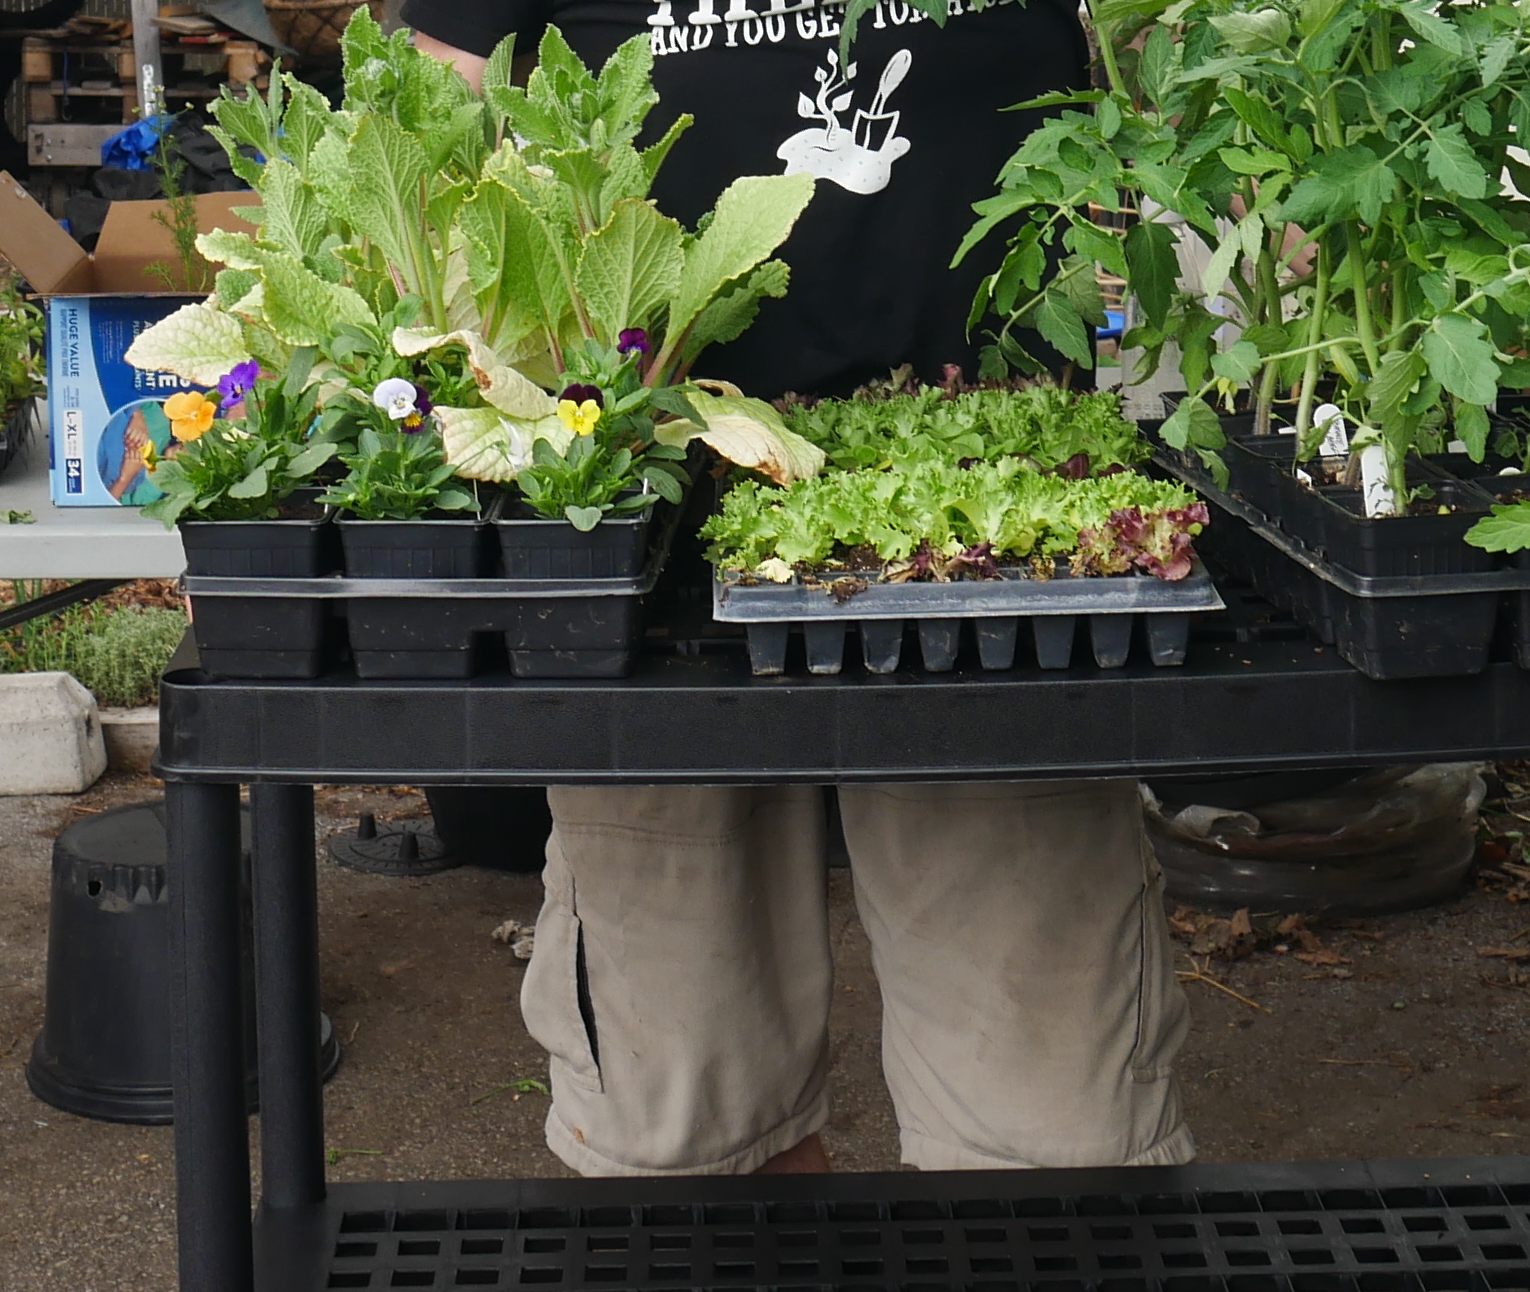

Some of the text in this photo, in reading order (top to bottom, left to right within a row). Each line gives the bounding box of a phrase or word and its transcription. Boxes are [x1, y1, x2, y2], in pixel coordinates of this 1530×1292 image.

[651, 23, 714, 56] AND
[724, 14, 786, 47] YOU
[796, 2, 845, 40] GE
[68, 308, 78, 340] HUGE
[69, 341, 80, 377] VALUE
[67, 459, 81, 478] 34
